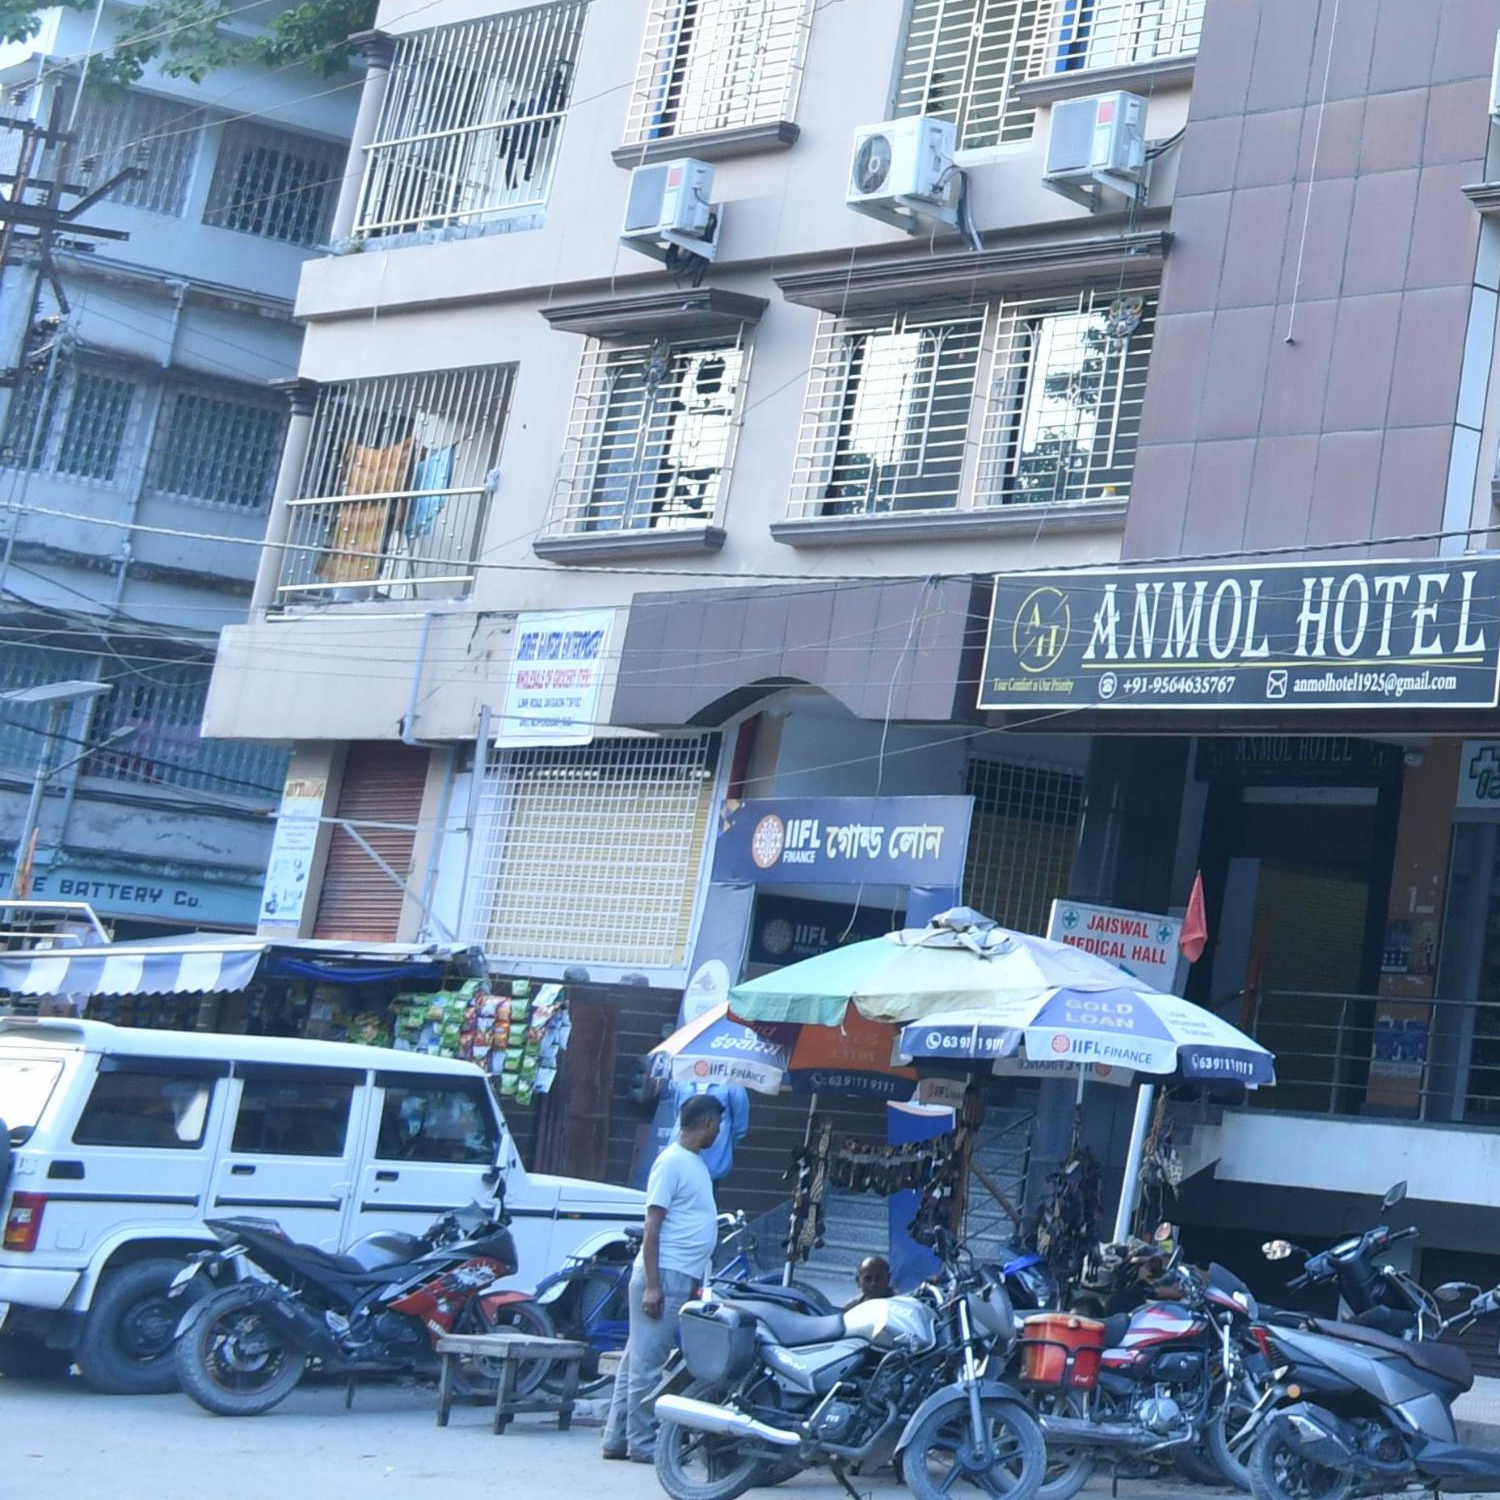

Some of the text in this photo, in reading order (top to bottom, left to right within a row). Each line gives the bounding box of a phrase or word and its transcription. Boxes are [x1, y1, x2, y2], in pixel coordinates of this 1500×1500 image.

[1082, 570, 1486, 661] ANMOL HOTEL
[1123, 675, 1237, 694] +91-9564635767
[1294, 671, 1457, 697] anmolhotel1925@gmail.com
[784, 818, 822, 850] IIFL
[888, 823, 945, 860] লোন
[783, 850, 817, 864] FINANCE
[59, 879, 163, 903] BATTERY
[1087, 914, 1149, 938] JAISWAL
[1062, 934, 1167, 964] MEDICAL HALL
[1064, 998, 1135, 1014] GOLD
[1064, 1011, 1136, 1028] LOAN
[942, 1035, 958, 1049] 63
[1071, 1039, 1153, 1065] IIFL FINANCE
[709, 1063, 766, 1085] IIFL FINANCE
